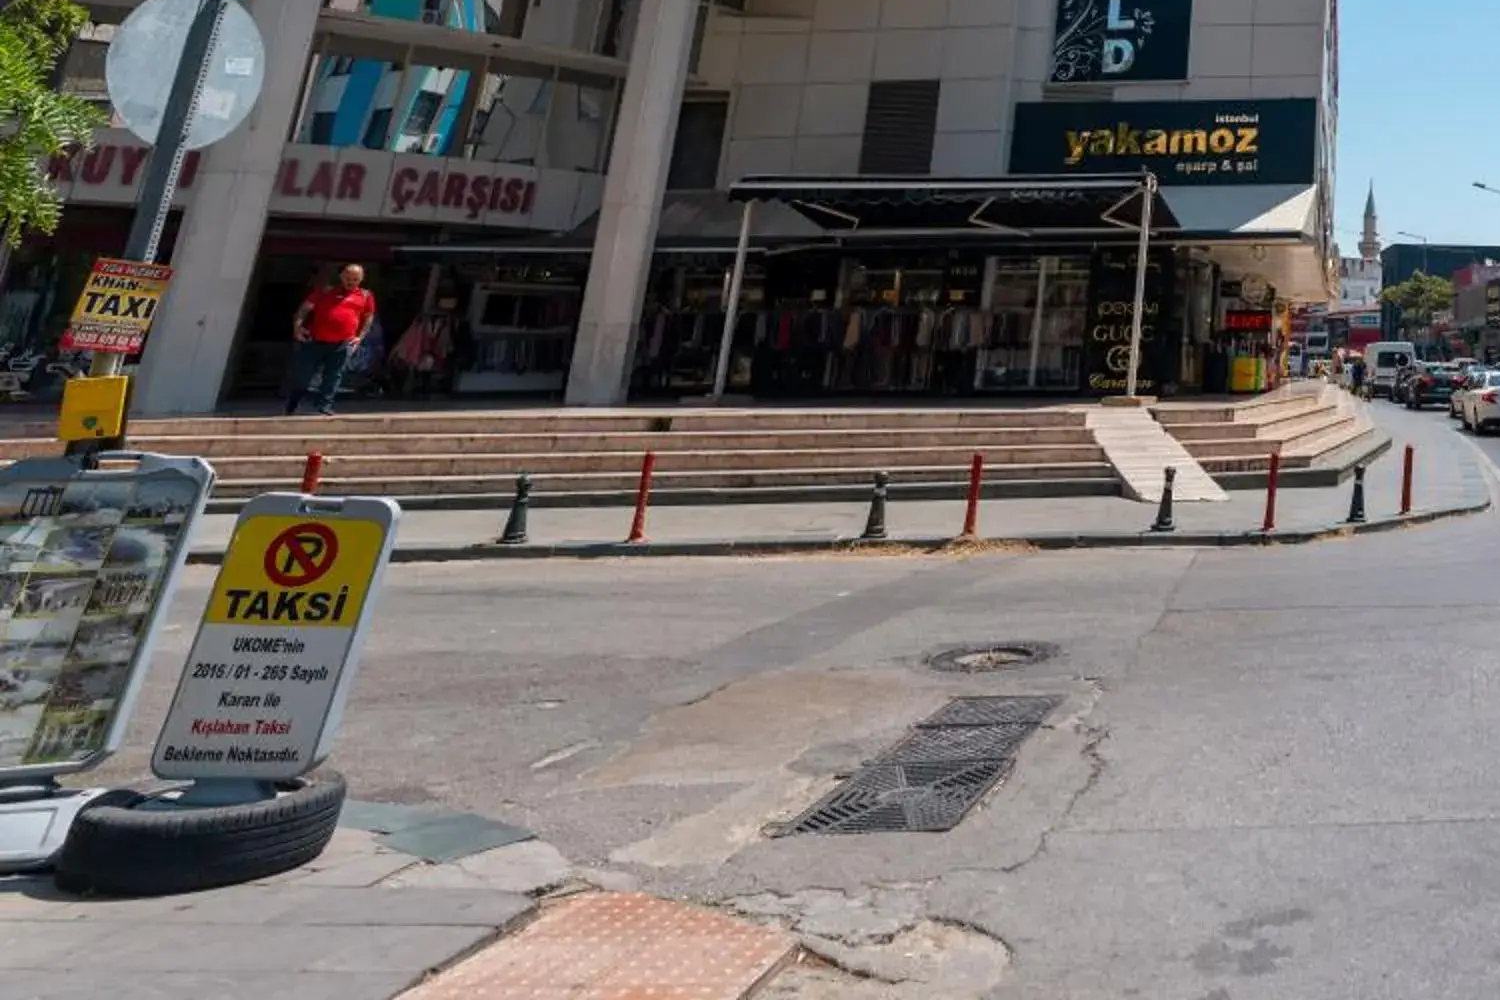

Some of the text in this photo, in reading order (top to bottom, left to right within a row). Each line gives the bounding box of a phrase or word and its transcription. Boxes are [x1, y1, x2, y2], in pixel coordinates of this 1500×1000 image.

[1064, 121, 1258, 165] yakamoz
[391, 167, 536, 218] ÇARŞISI
[84, 292, 157, 318] TAXI
[225, 585, 349, 622] TAKSİ
[255, 719, 292, 735] Taksi
[164, 745, 223, 762] Bekleme
